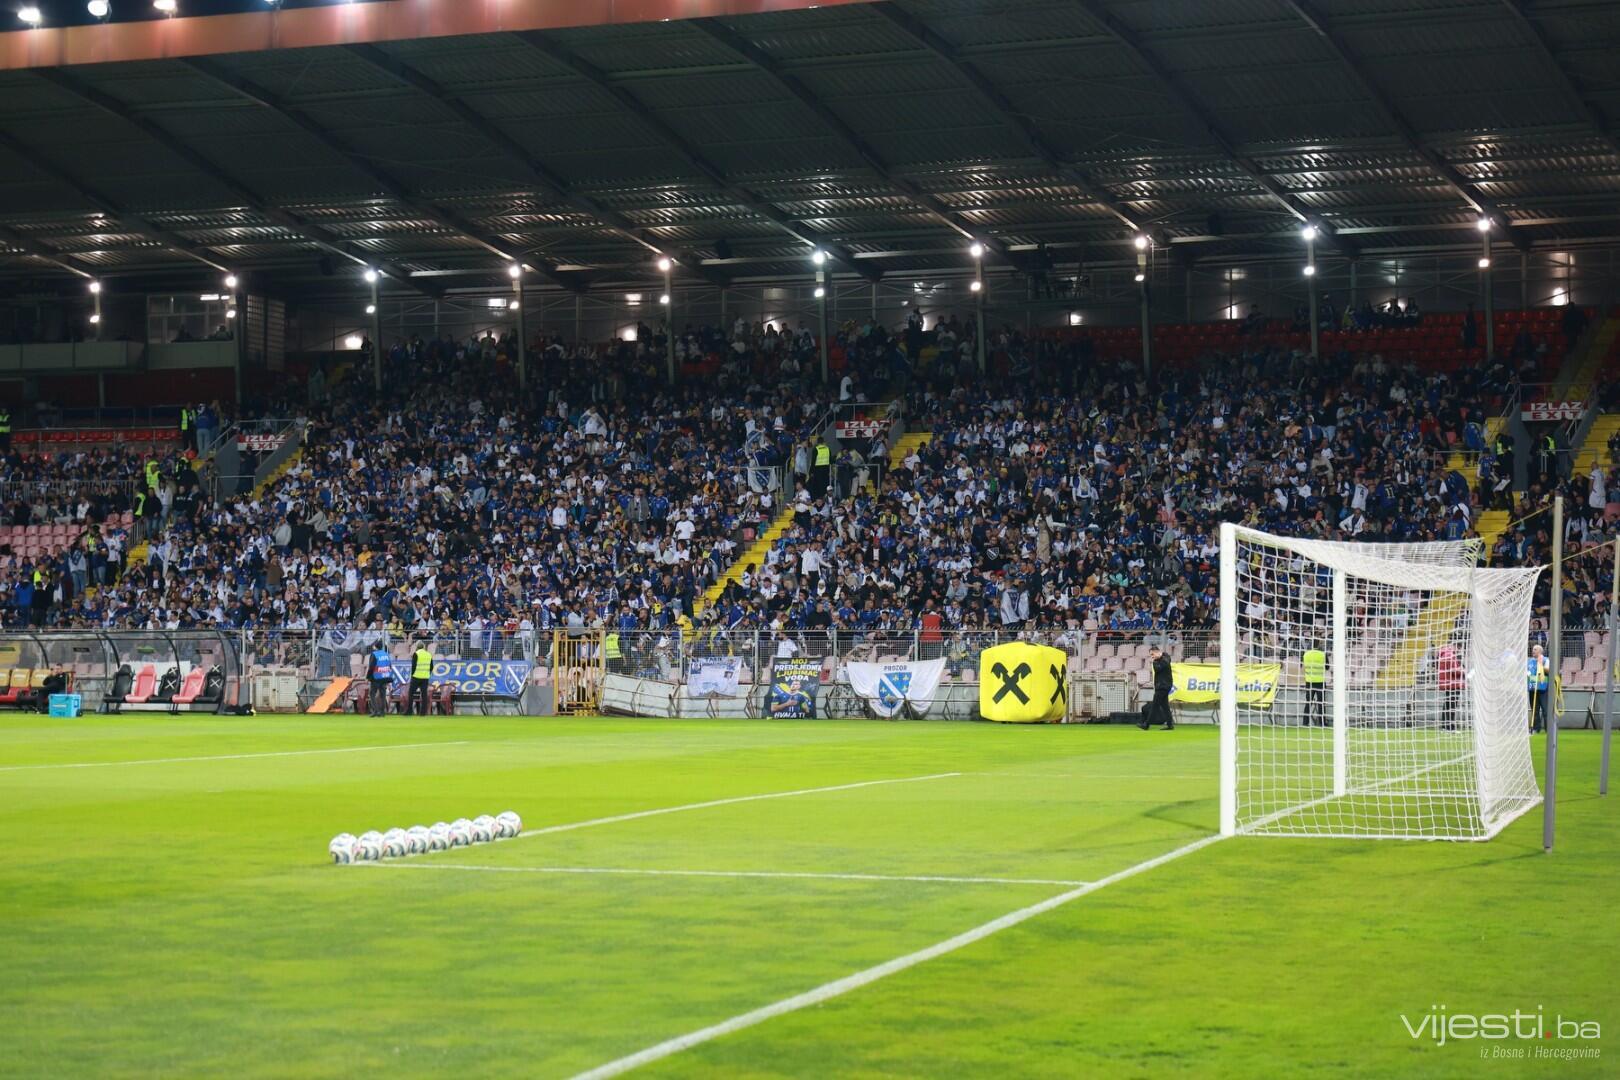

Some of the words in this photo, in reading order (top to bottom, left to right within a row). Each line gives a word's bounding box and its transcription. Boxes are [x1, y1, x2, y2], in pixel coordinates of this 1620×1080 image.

[1530, 401, 1582, 410] IZLAZ
[1532, 410, 1580, 419] EXIT
[432, 662, 503, 677] OTOR
[1187, 678, 1221, 693] Banj
[774, 711, 797, 719] HVALA
